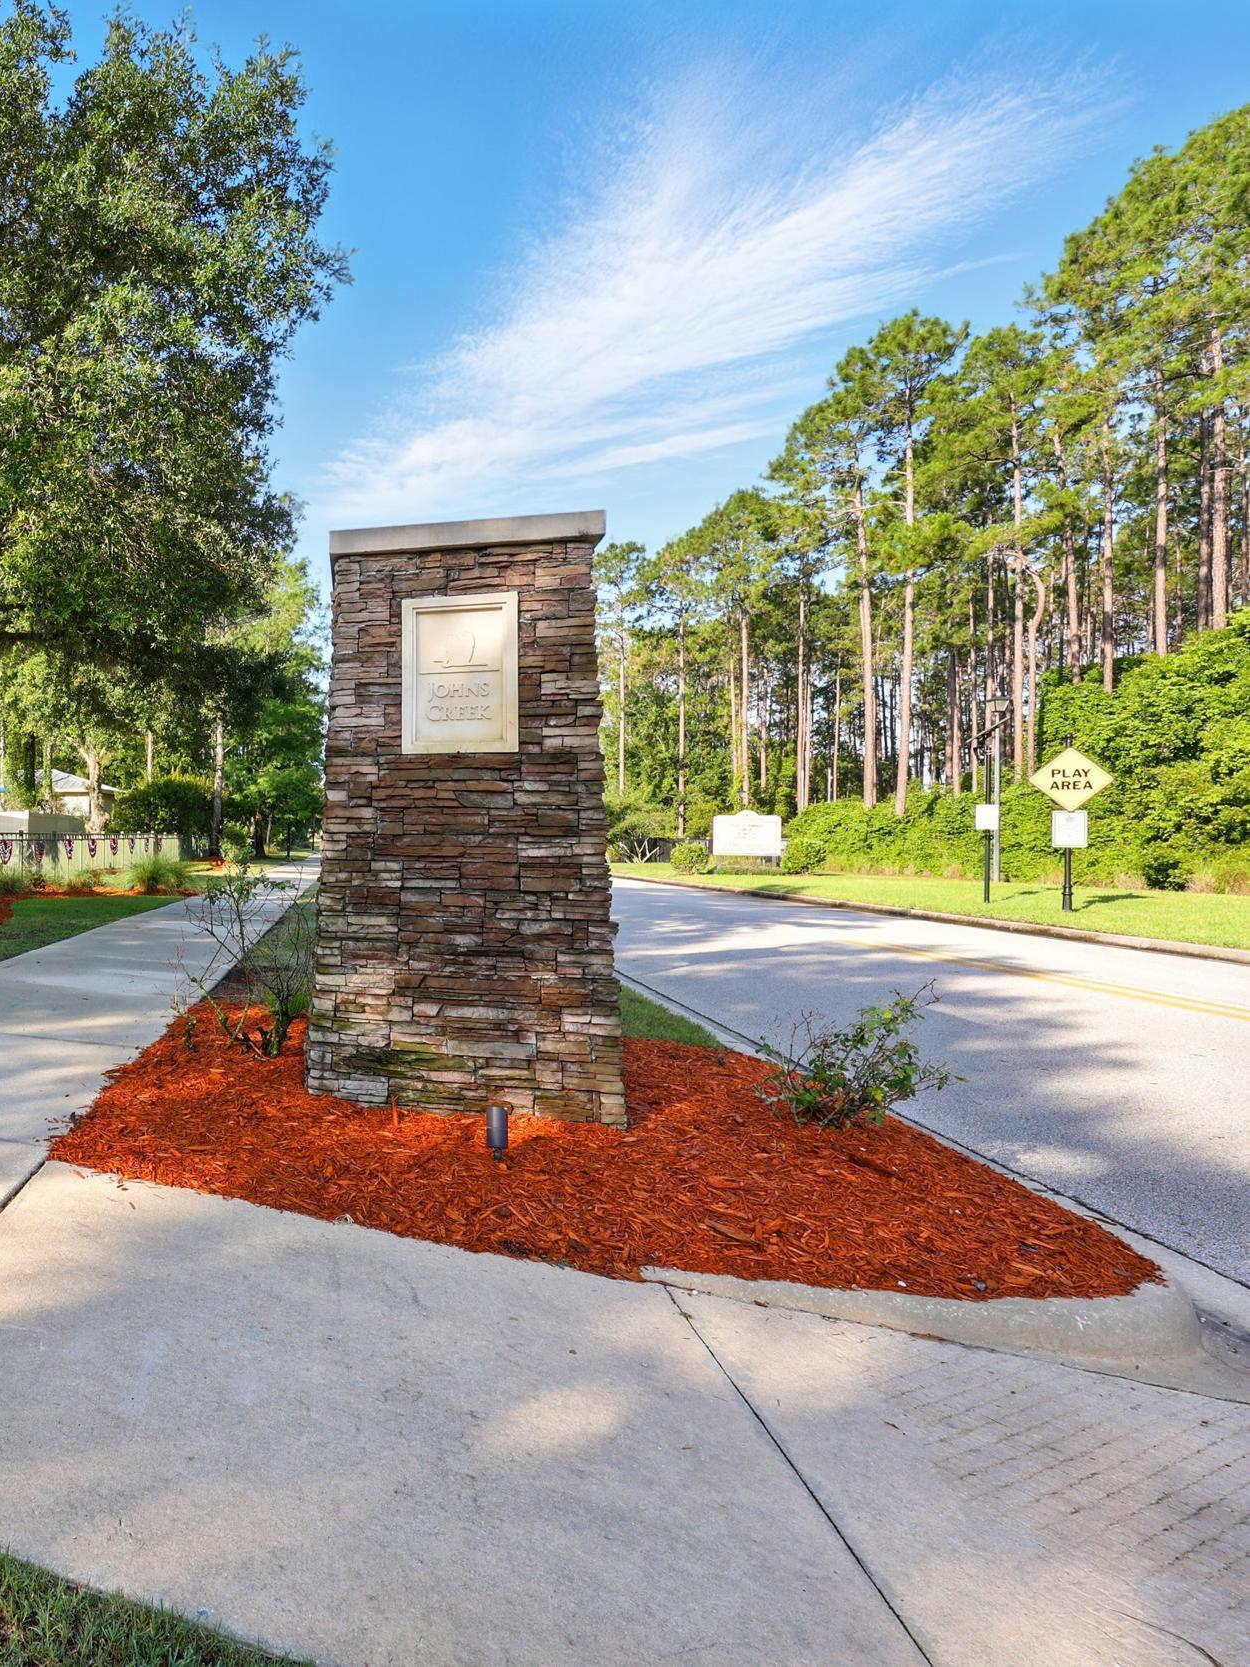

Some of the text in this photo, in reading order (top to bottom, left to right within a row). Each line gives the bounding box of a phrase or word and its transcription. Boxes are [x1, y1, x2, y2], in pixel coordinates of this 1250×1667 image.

[428, 682, 491, 703] JOHNS
[426, 705, 492, 722] CREEK
[1051, 768, 1091, 778] PLAY
[1050, 780, 1093, 790] AREA
